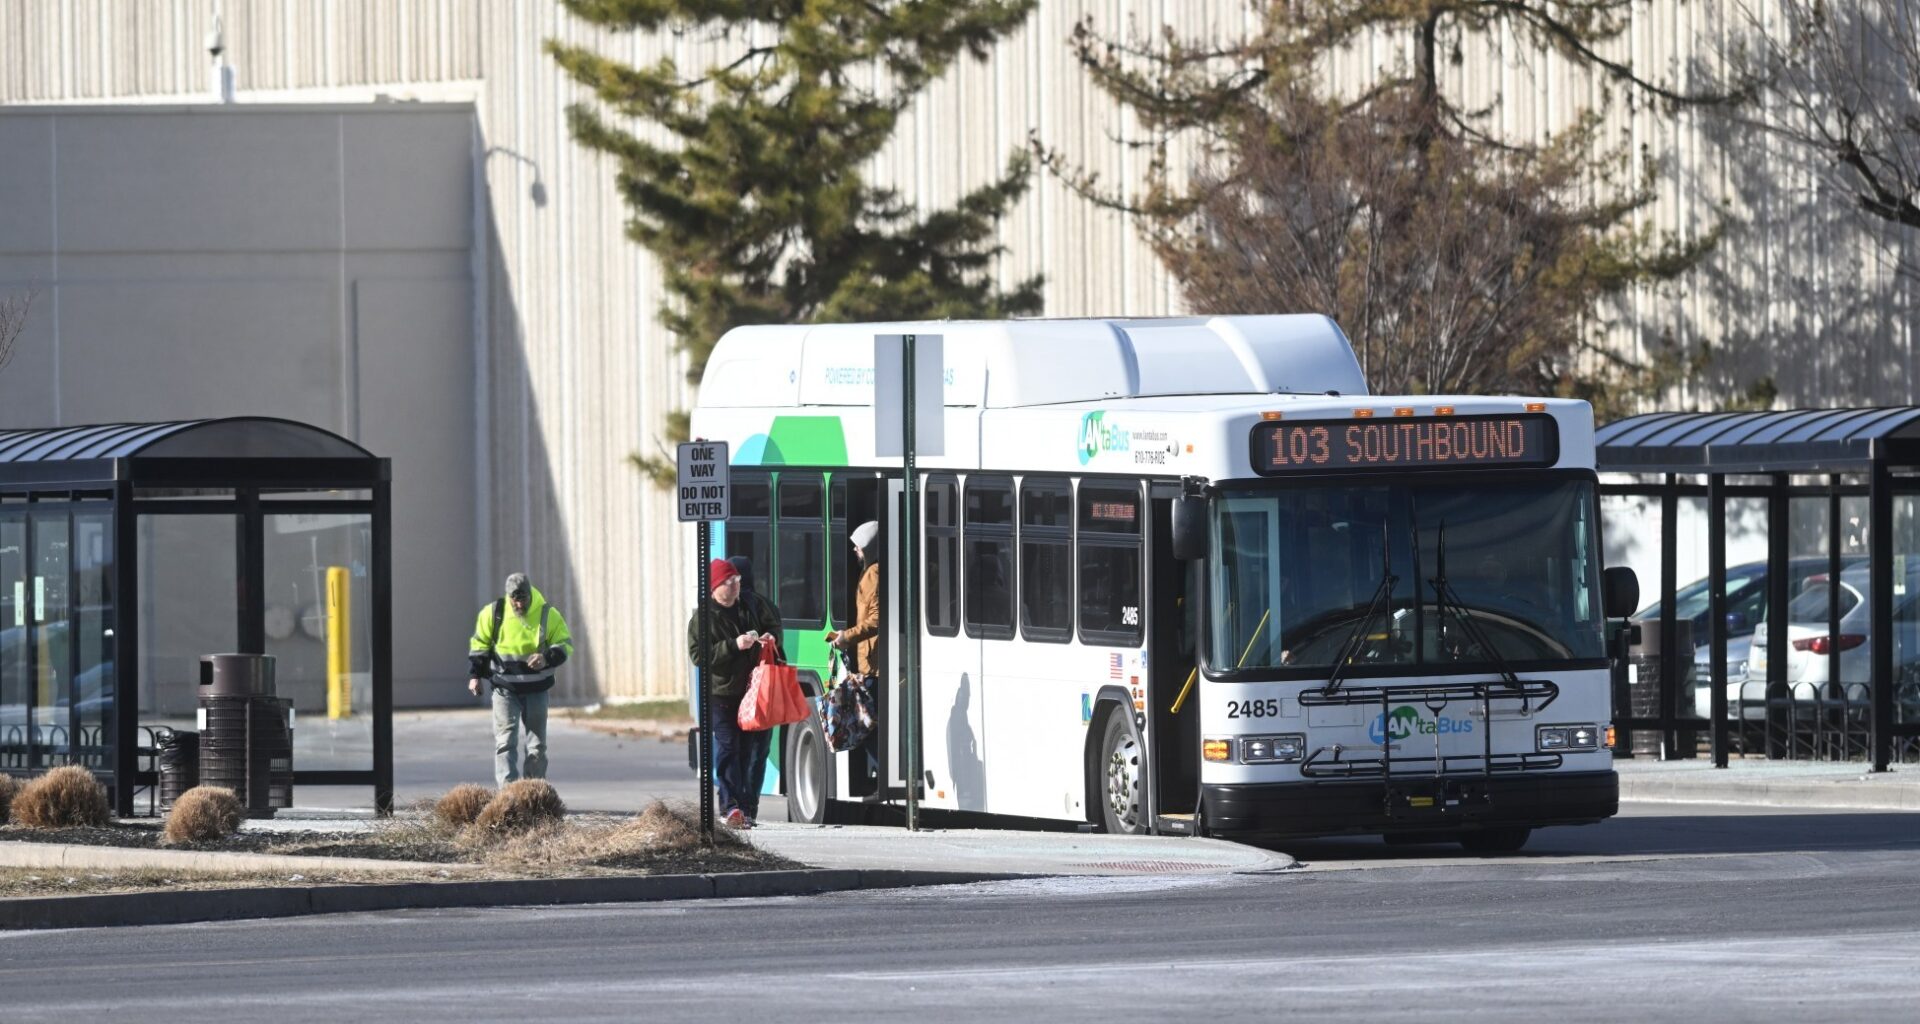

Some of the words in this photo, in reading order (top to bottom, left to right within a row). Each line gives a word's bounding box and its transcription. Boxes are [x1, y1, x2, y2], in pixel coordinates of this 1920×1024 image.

[1271, 427, 1330, 465] 103
[1346, 420, 1524, 463] SOUTHBOUND
[691, 447, 715, 461] ONE
[690, 463, 716, 478] WAY
[681, 486, 698, 500] DO
[701, 485, 725, 499] NOT
[685, 502, 722, 516] ENTER
[1121, 605, 1139, 626] 2485
[1226, 698, 1278, 719] 2485
[1371, 712, 1473, 738] LANtaBus
